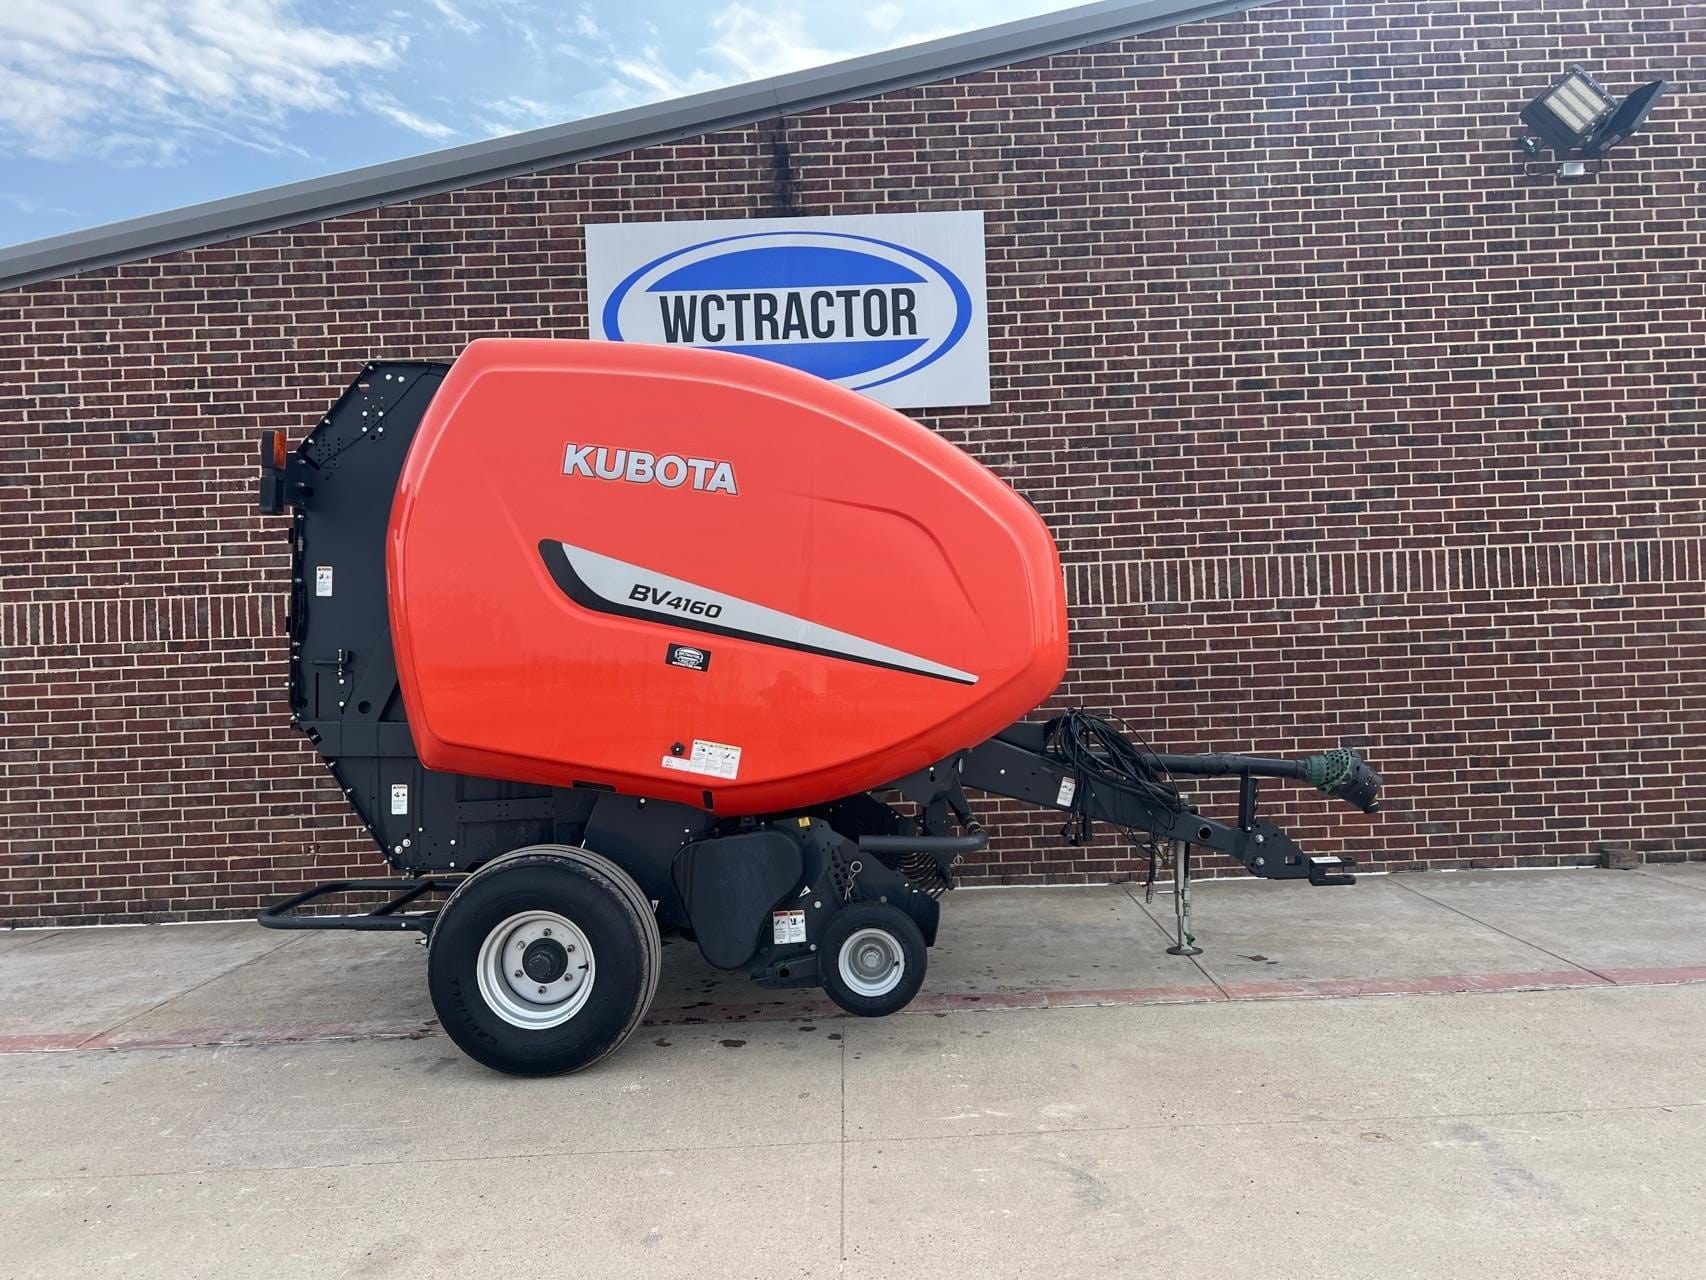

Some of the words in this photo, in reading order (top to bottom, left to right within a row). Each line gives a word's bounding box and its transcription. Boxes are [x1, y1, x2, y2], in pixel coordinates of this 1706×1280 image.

[659, 287, 918, 343] WCTRACTOR
[562, 443, 738, 495] KUBOTA
[628, 583, 722, 618] BV4160
